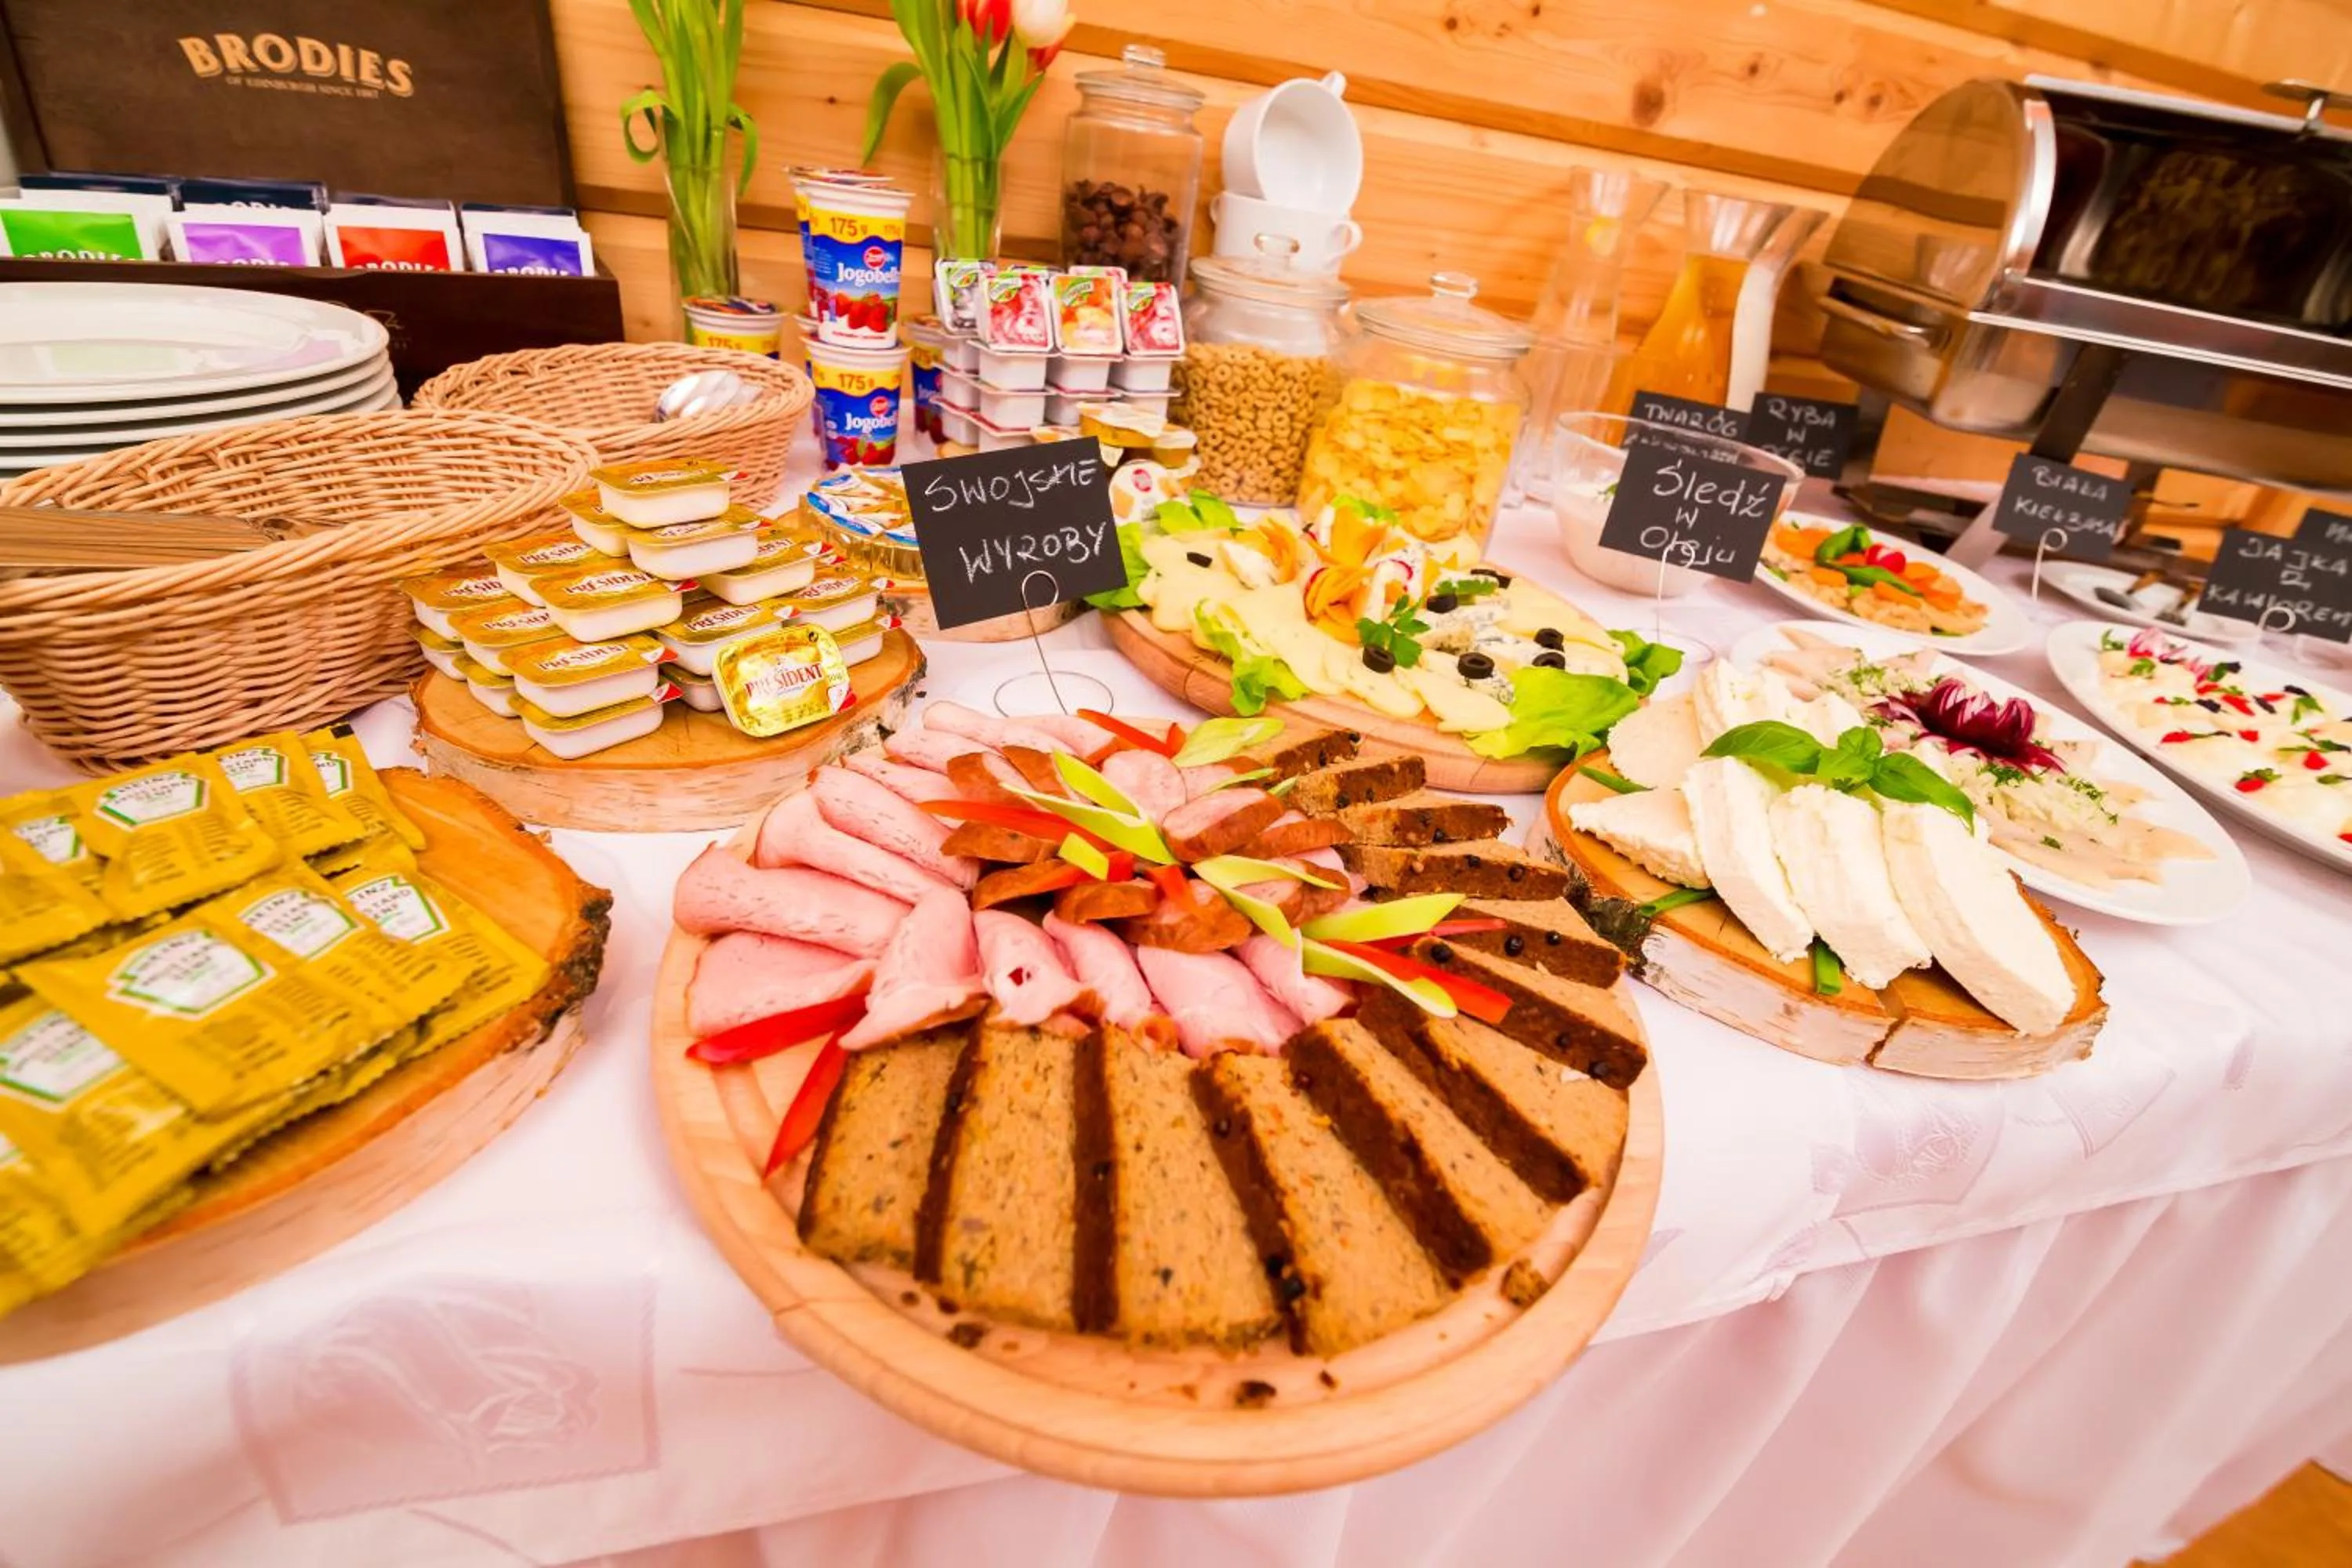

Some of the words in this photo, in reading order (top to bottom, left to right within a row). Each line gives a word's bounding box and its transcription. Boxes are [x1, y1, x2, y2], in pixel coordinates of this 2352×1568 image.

[177, 33, 414, 97] BRODIES
[830, 216, 858, 238] 175
[838, 372, 866, 390] 175
[1766, 397, 1837, 430] RYBA
[924, 459, 1098, 513] SWOJSKIE
[1653, 459, 1771, 517] Śledź
[958, 521, 1107, 584] WYROBY
[2238, 536, 2348, 577] JAJKA
